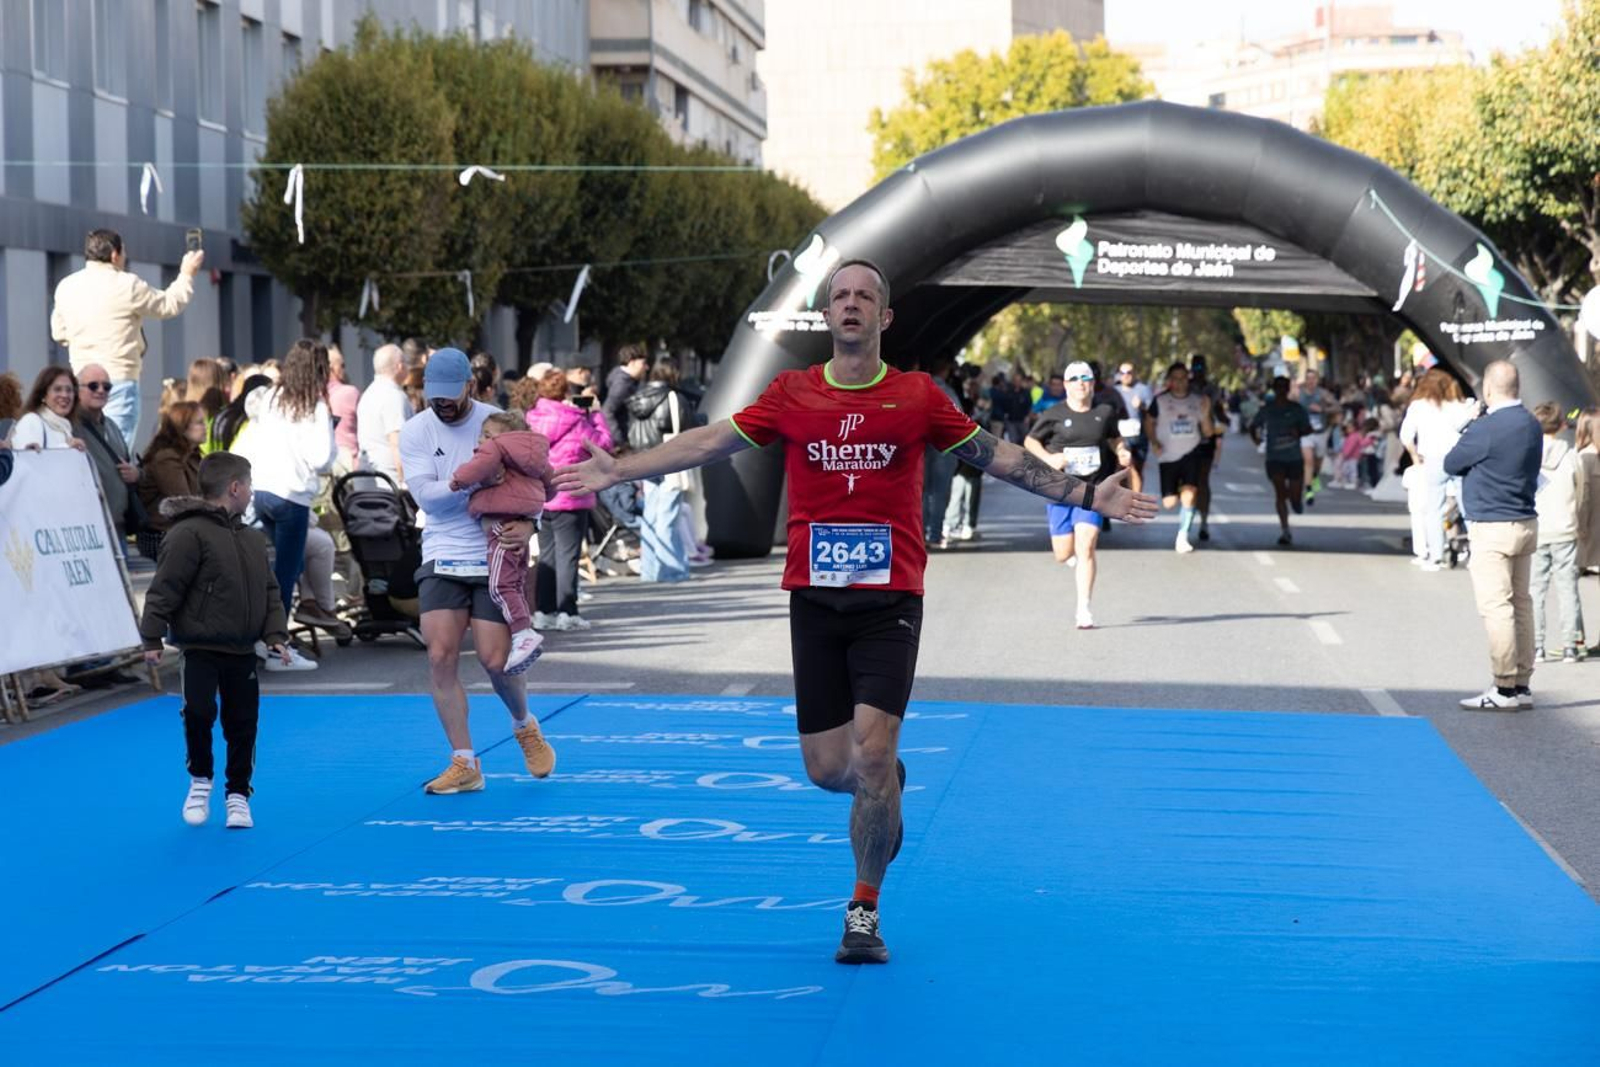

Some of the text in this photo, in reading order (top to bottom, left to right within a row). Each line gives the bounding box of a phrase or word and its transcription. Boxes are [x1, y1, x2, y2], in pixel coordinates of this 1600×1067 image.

[1097, 240, 1276, 262] Patronato Municipal de
[1097, 258, 1234, 278] Deportes de Jaén
[807, 439, 897, 466] Sherry
[822, 459, 881, 471] Maratón
[60, 524, 104, 553] RURAL
[816, 541, 886, 563] 2643
[187, 974, 408, 984] MEDIA
